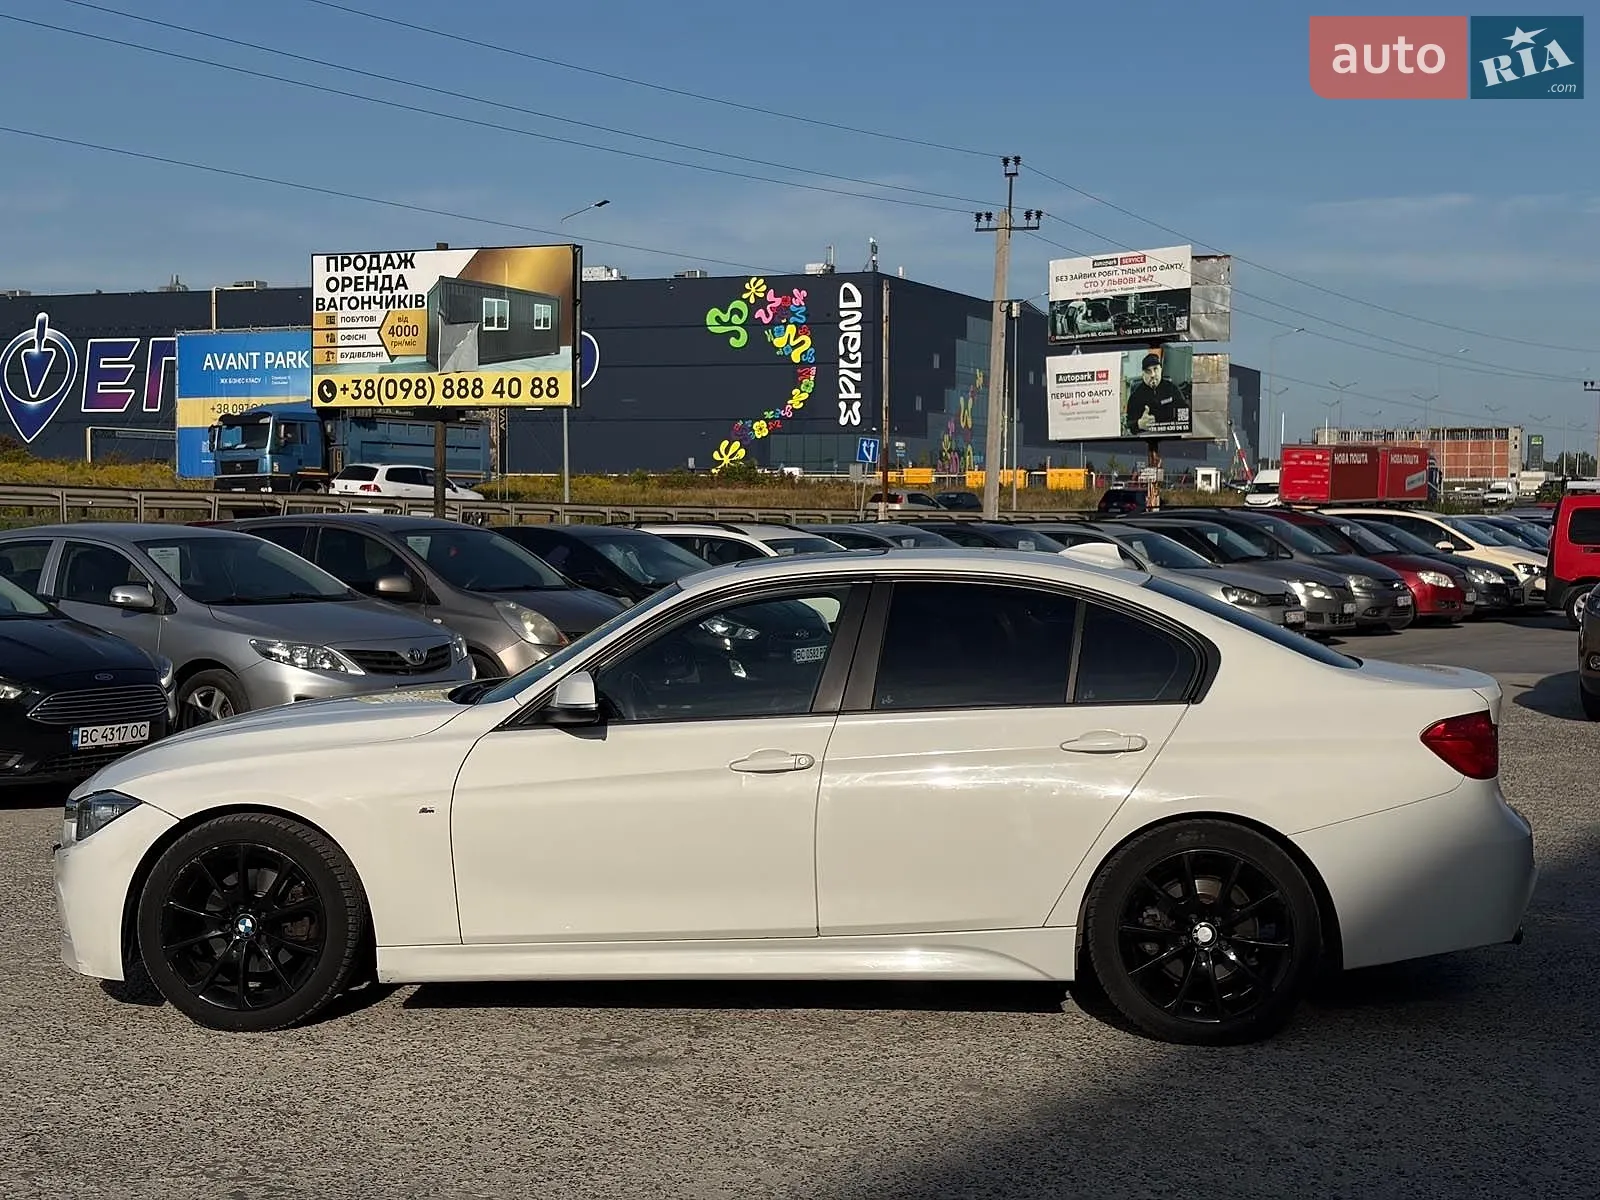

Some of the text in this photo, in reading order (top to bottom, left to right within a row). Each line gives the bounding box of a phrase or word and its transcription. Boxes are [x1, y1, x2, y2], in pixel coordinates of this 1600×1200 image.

[326, 252, 416, 274] ПРОДАЖ
[325, 273, 409, 295] ОРЕНДА
[1055, 274, 1068, 283] БЕЗ
[1084, 281, 1099, 289] СТО
[1100, 280, 1106, 288] У
[1106, 277, 1137, 287] ЛЬВОВІ
[315, 293, 426, 312] ВАГОНЧИКІВ
[340, 314, 377, 323] ПОБУТОВІ
[397, 315, 409, 324] від
[388, 324, 419, 338] 4000
[340, 333, 367, 341] ОФІСНІ
[390, 339, 417, 348] грн/міс
[202, 350, 310, 371] AVANT PARK
[340, 351, 384, 360] БУДІВЕЛЬНІ
[1058, 371, 1092, 383] Autopark
[340, 376, 560, 406] +38(098) 888 40 88
[1051, 391, 1074, 400] ПЕРШІ
[210, 403, 230, 414] +38
[1334, 453, 1369, 464] НОВА ПОШТА
[1390, 454, 1419, 464] НОВА ПОШТА
[80, 724, 147, 745] BC 4317 OC
